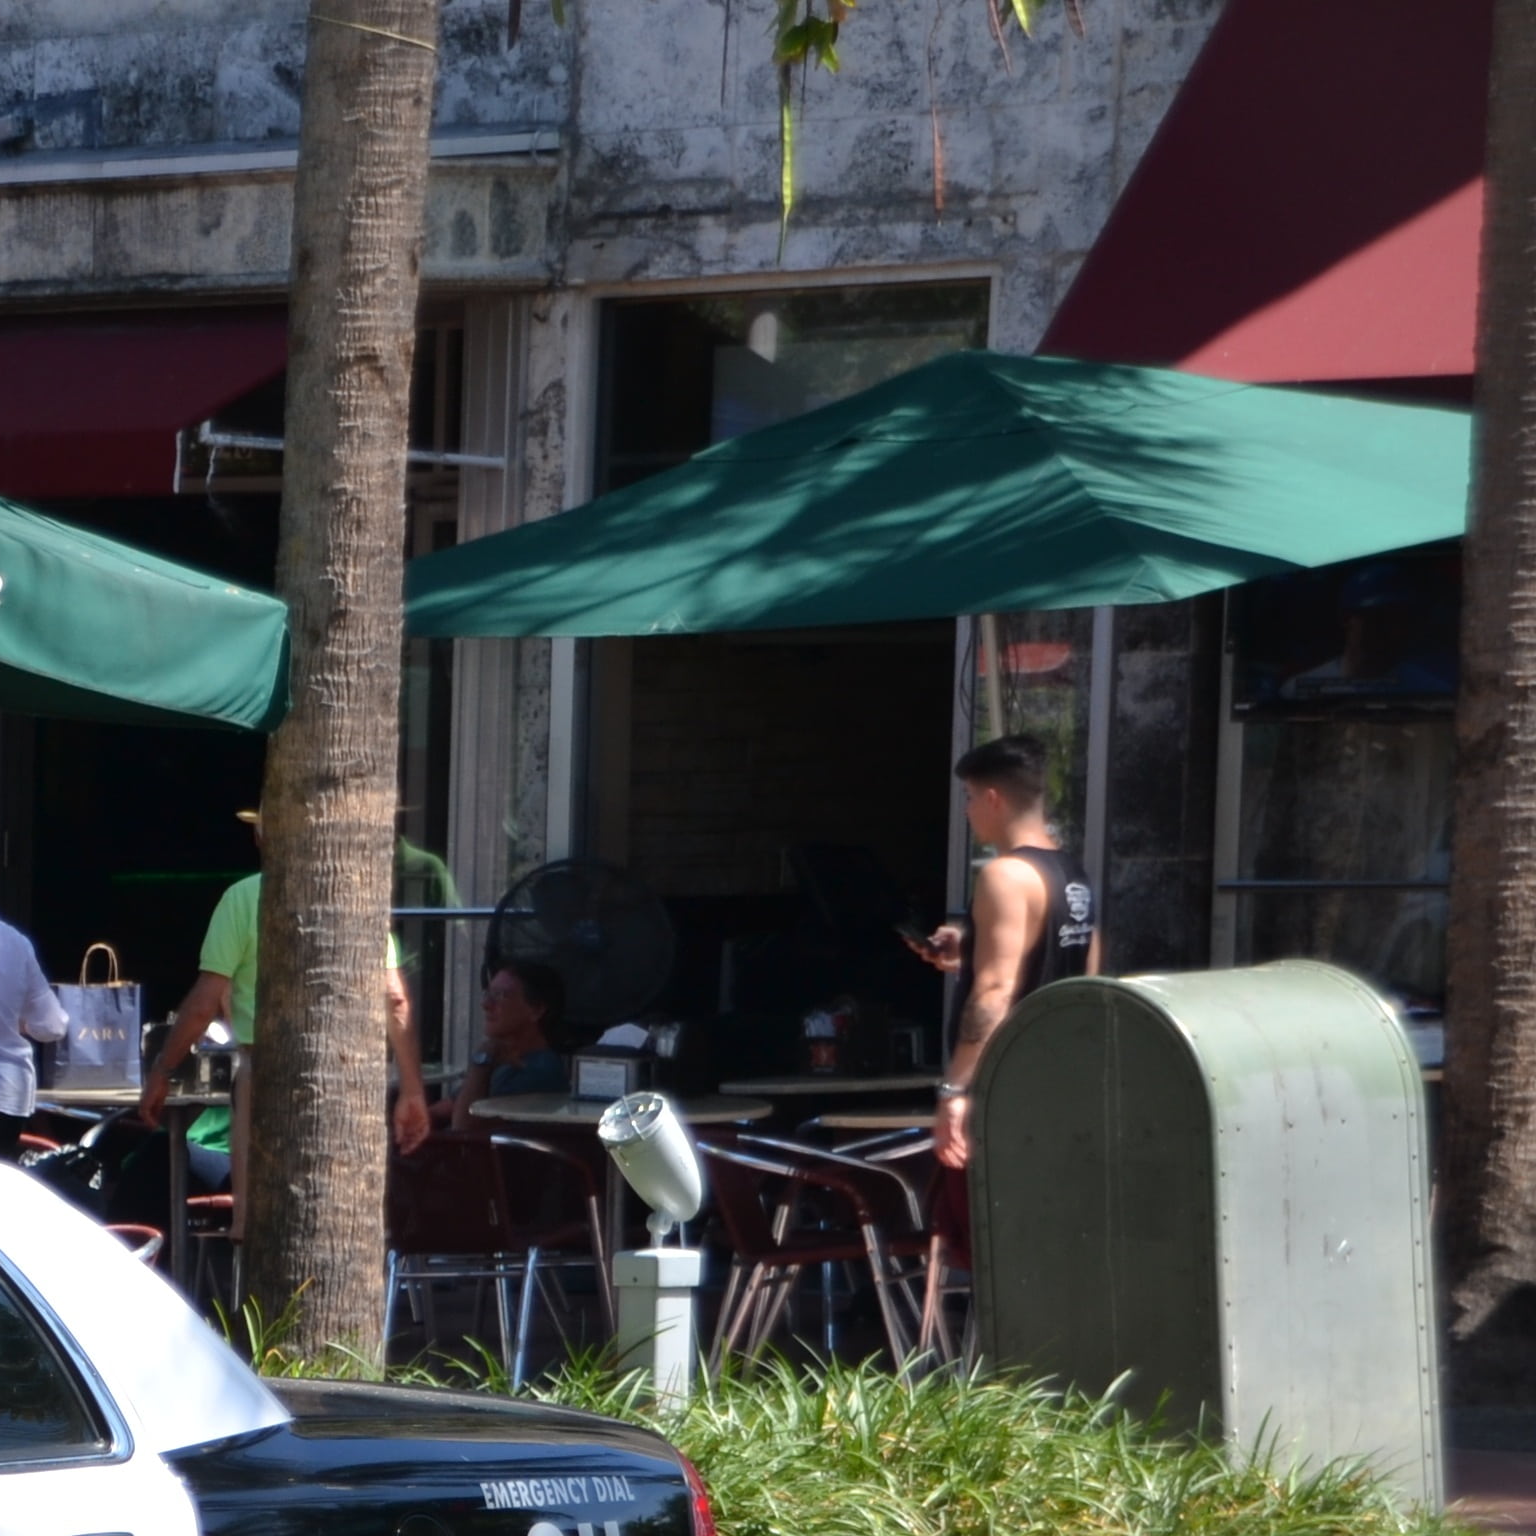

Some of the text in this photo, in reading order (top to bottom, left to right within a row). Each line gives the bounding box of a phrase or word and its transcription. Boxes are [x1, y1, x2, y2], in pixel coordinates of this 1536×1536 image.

[77, 1026, 126, 1041] ZARA
[479, 1475, 636, 1510] EMERGENCY DIAL
